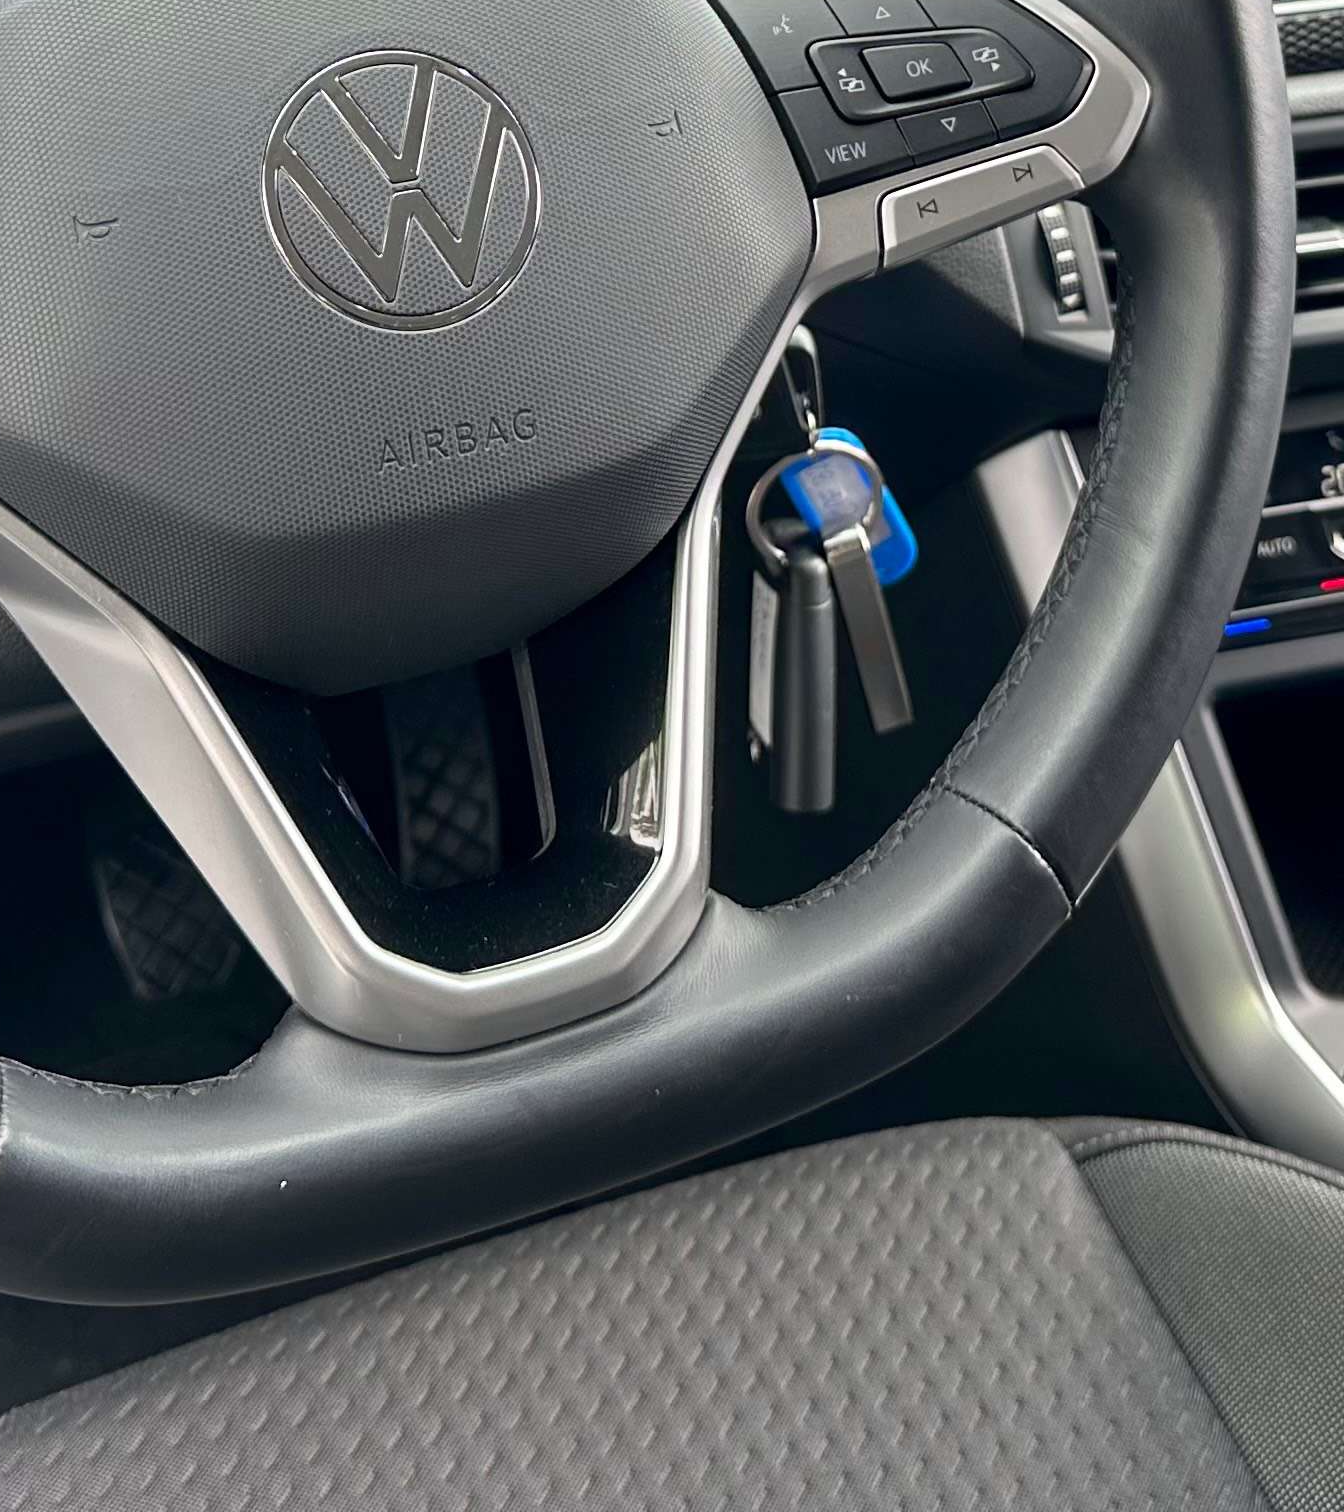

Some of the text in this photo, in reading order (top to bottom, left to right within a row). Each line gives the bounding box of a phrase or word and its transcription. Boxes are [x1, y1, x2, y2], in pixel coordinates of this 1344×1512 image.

[904, 56, 934, 77] OK
[824, 141, 868, 165] VIEW
[376, 407, 538, 473] AIRBAG
[1257, 536, 1297, 559] AUTO
